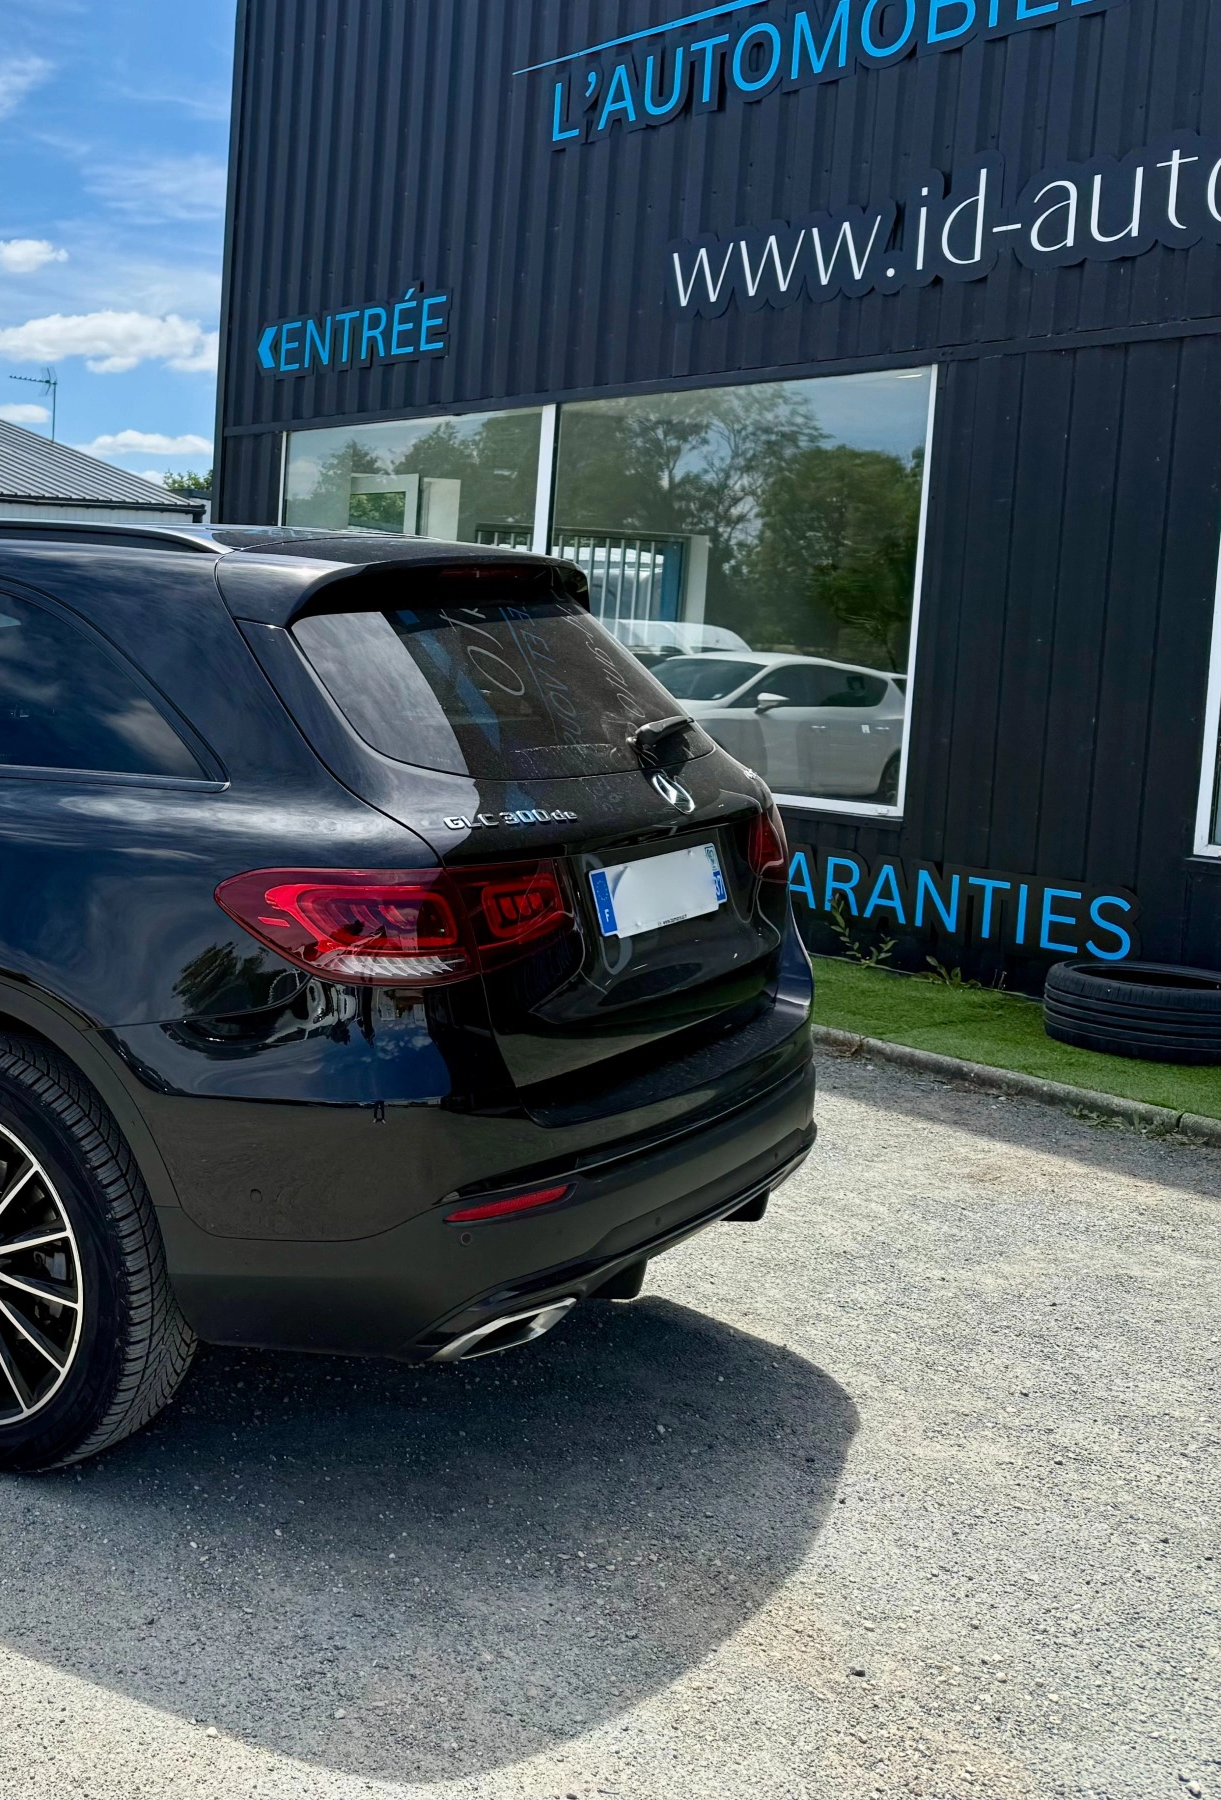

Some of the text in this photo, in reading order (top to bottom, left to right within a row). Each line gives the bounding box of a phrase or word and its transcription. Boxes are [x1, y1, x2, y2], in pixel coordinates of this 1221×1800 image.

[550, 0, 1096, 143] L'AUTOMOB
[279, 287, 447, 372] ENTRÉE
[442, 813, 500, 830] GLC
[788, 851, 1131, 960] ARANTIES
